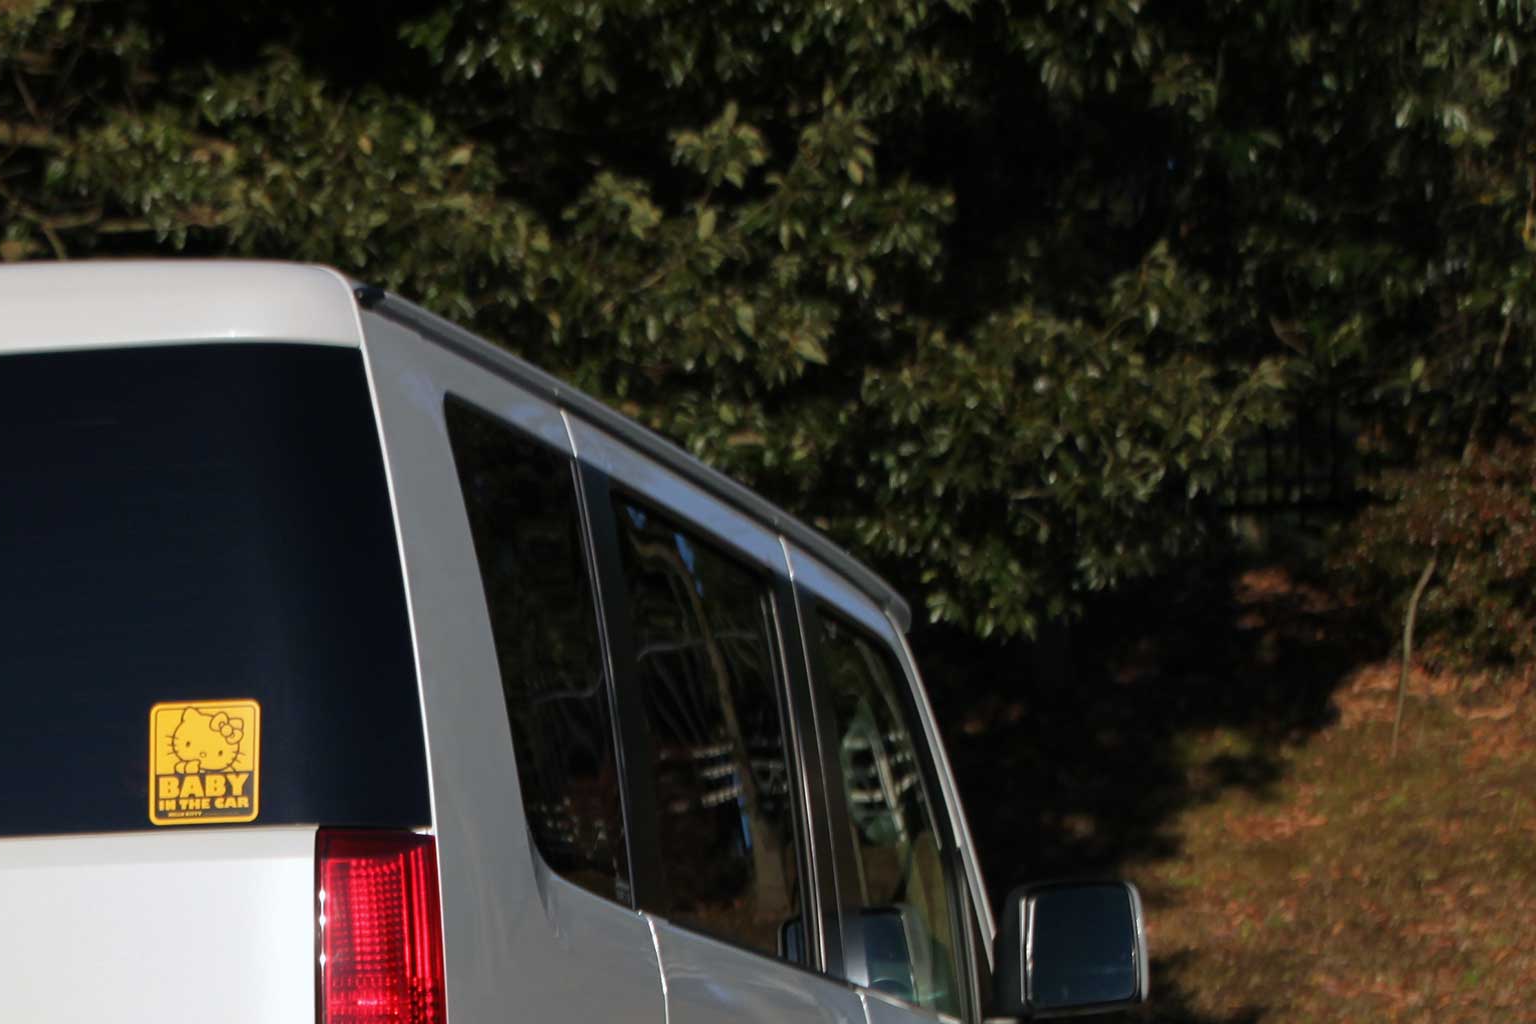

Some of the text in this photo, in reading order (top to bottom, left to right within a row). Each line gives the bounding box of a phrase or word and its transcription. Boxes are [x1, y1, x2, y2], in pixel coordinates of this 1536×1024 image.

[158, 773, 249, 799] BABY
[159, 796, 249, 811] IN THE CAR
